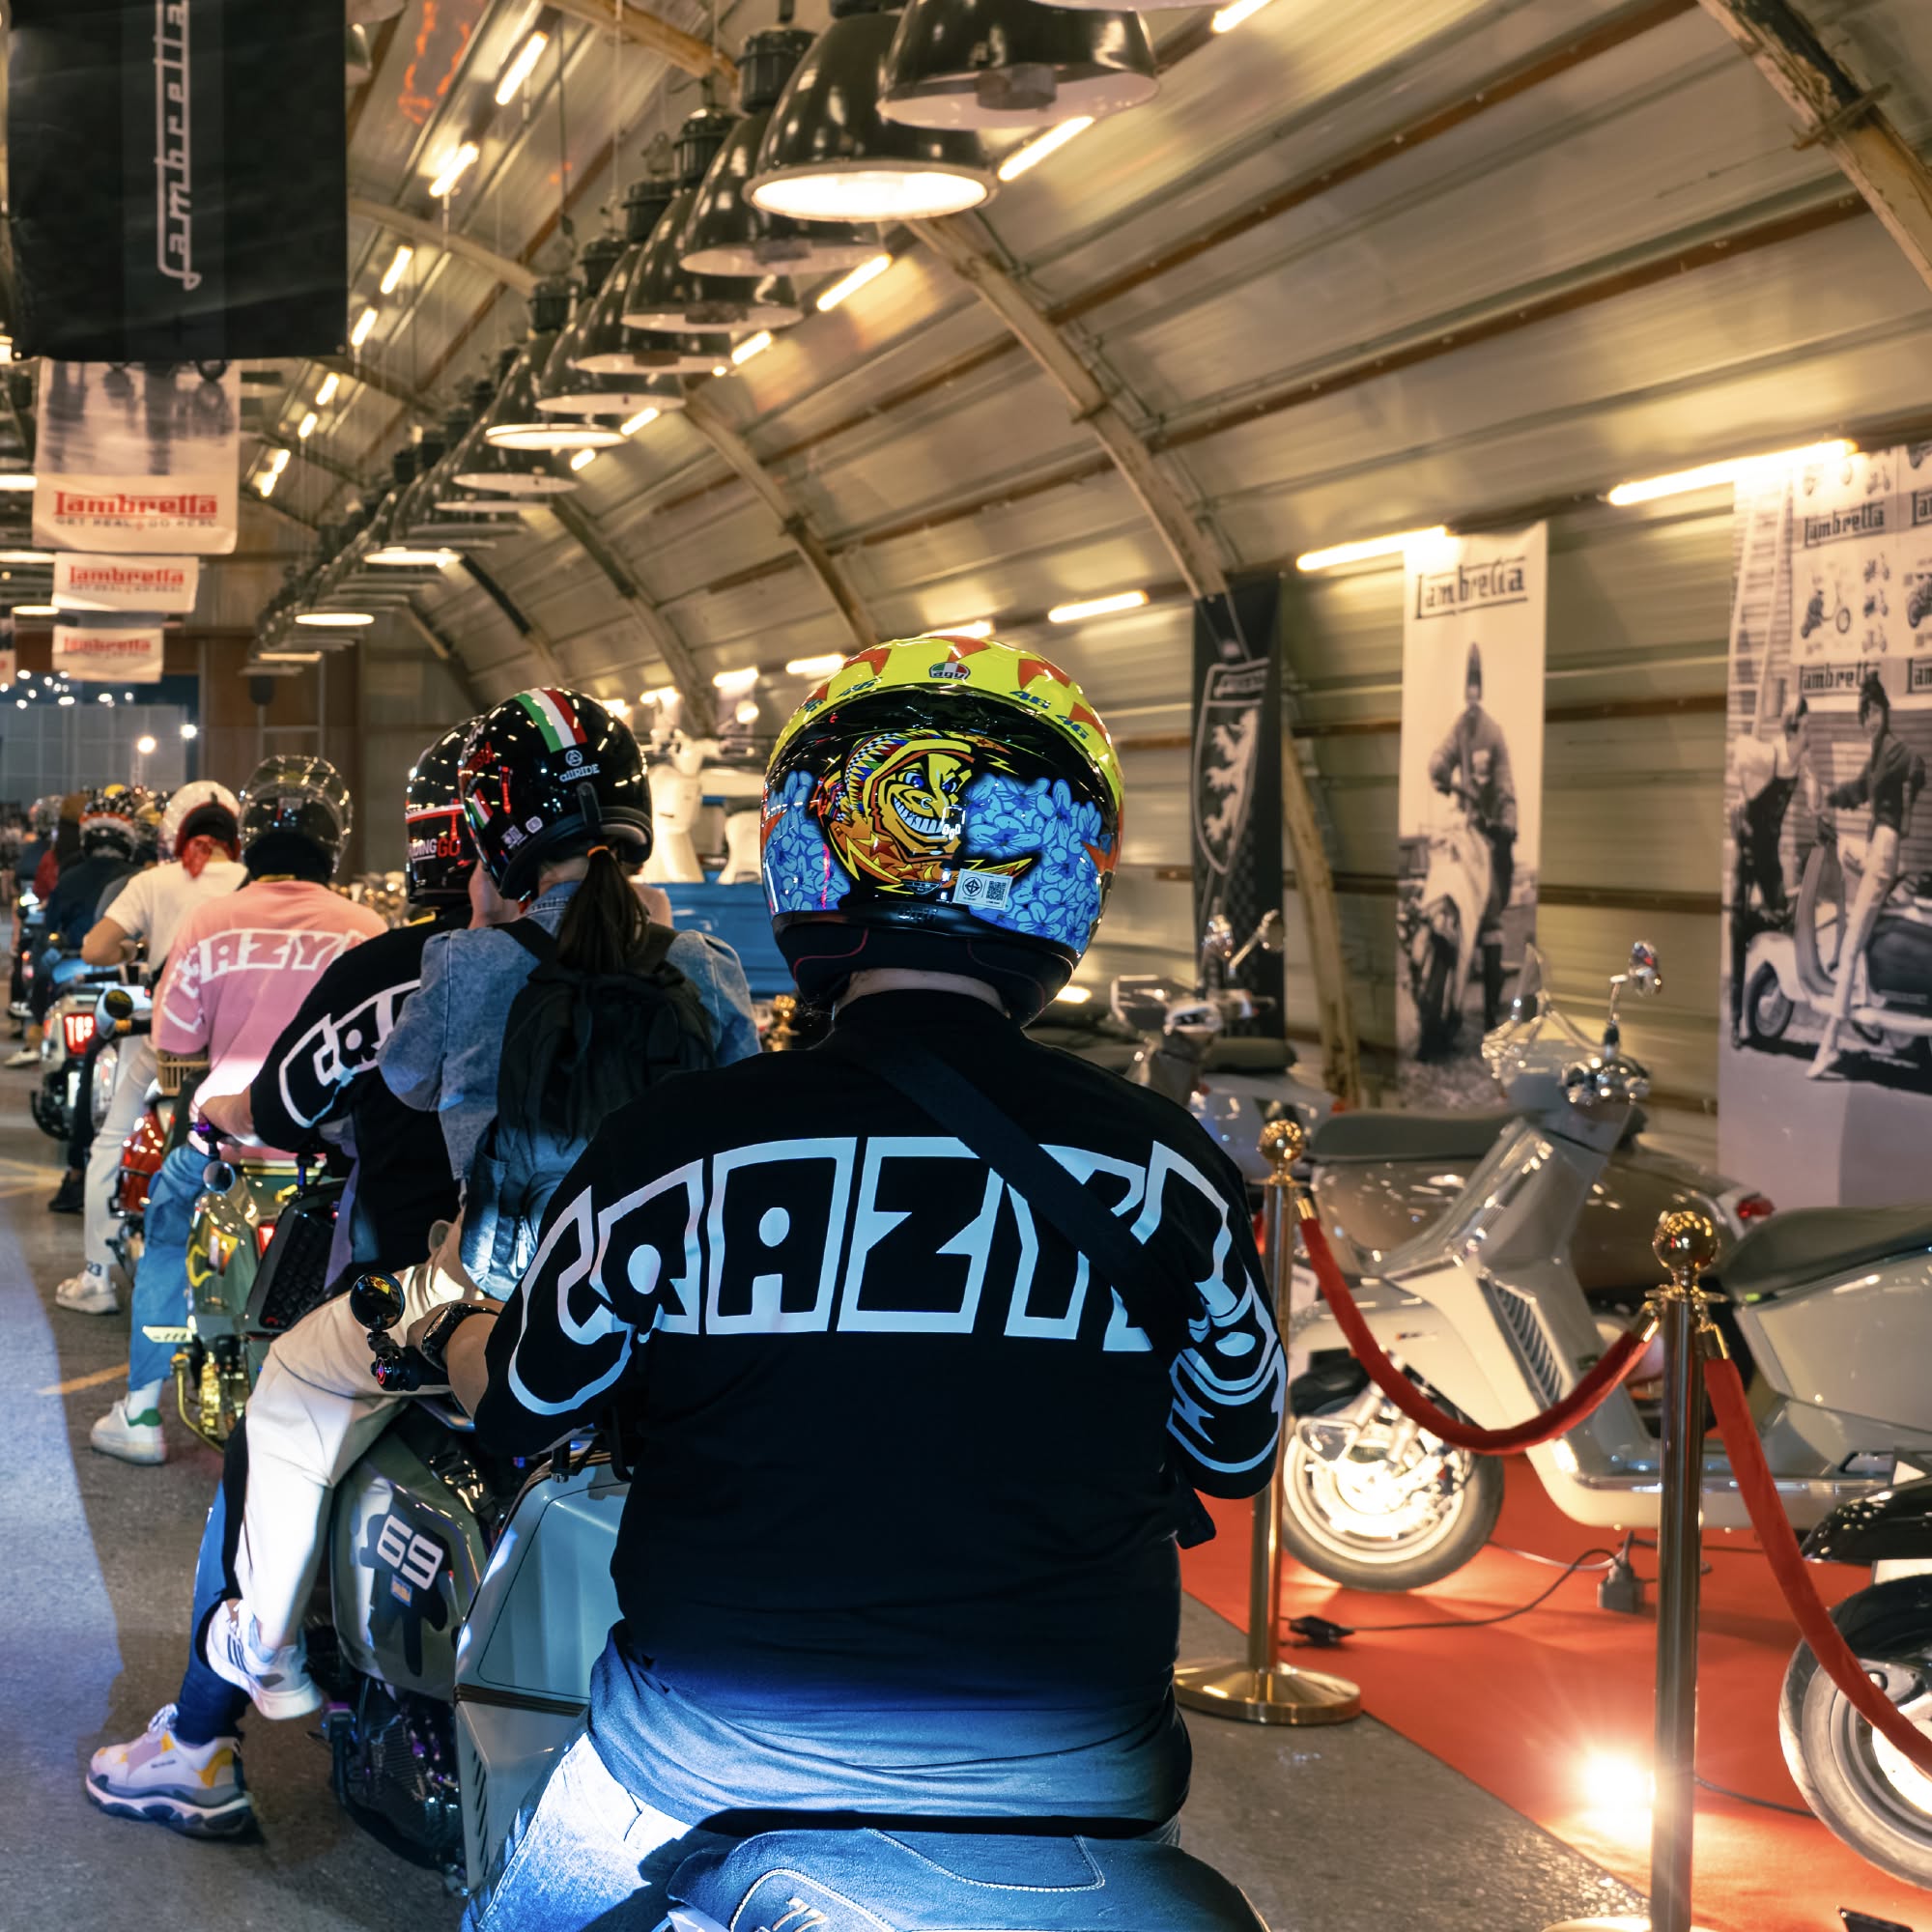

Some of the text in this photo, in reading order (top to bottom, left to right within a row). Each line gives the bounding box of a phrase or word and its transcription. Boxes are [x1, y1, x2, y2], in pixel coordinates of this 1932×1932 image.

[1009, 691, 1051, 710] 46
[1056, 714, 1090, 740] 46
[161, 927, 346, 1035] CAZY
[377, 1514, 444, 1591] 69
